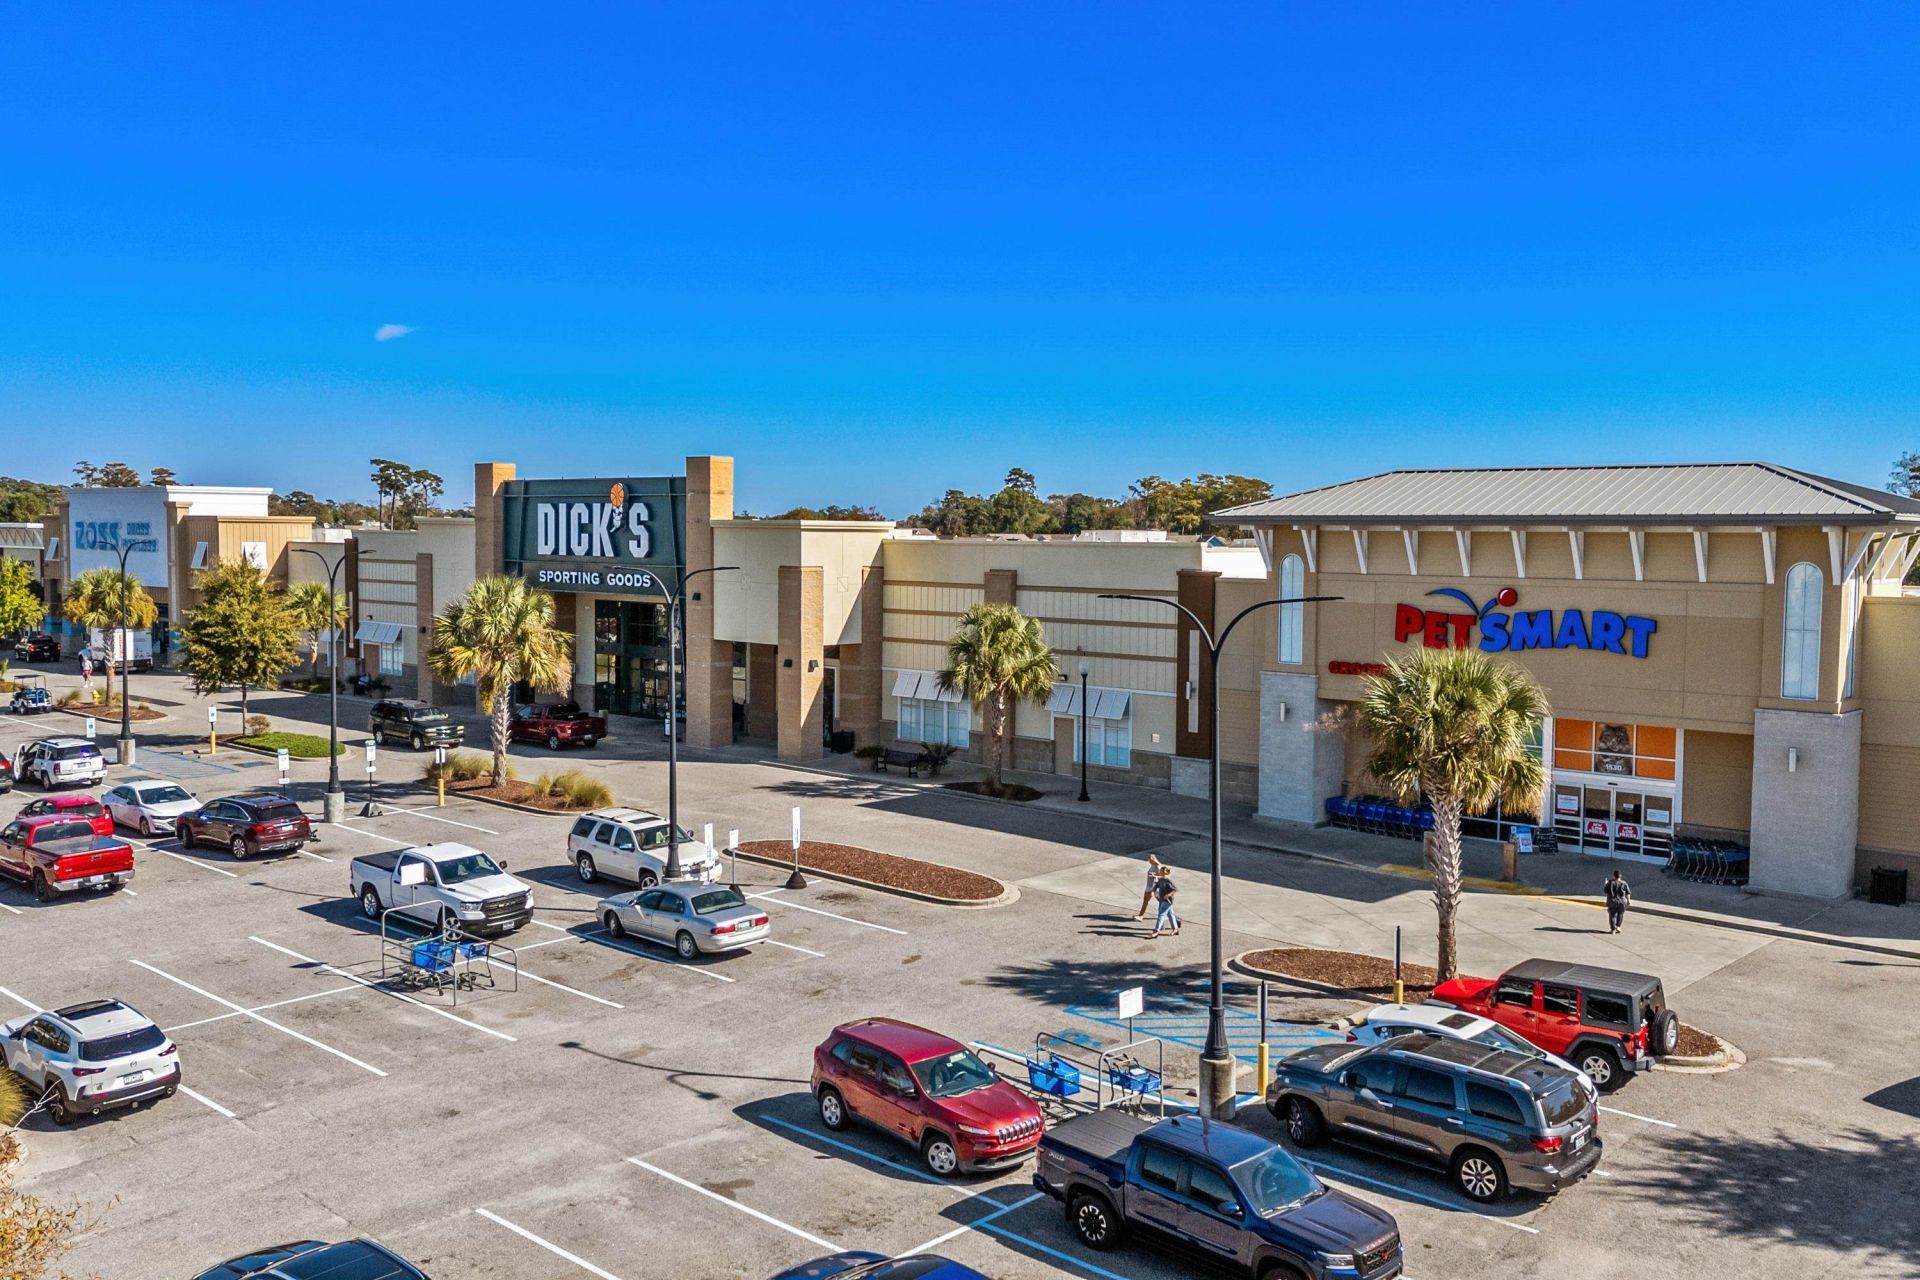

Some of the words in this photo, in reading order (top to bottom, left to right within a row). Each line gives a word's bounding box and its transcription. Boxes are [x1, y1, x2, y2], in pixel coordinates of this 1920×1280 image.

[75, 521, 120, 551] ROSS
[537, 502, 649, 559] DICK'S
[539, 569, 600, 585] SPORTING
[607, 573, 651, 588] GOODS
